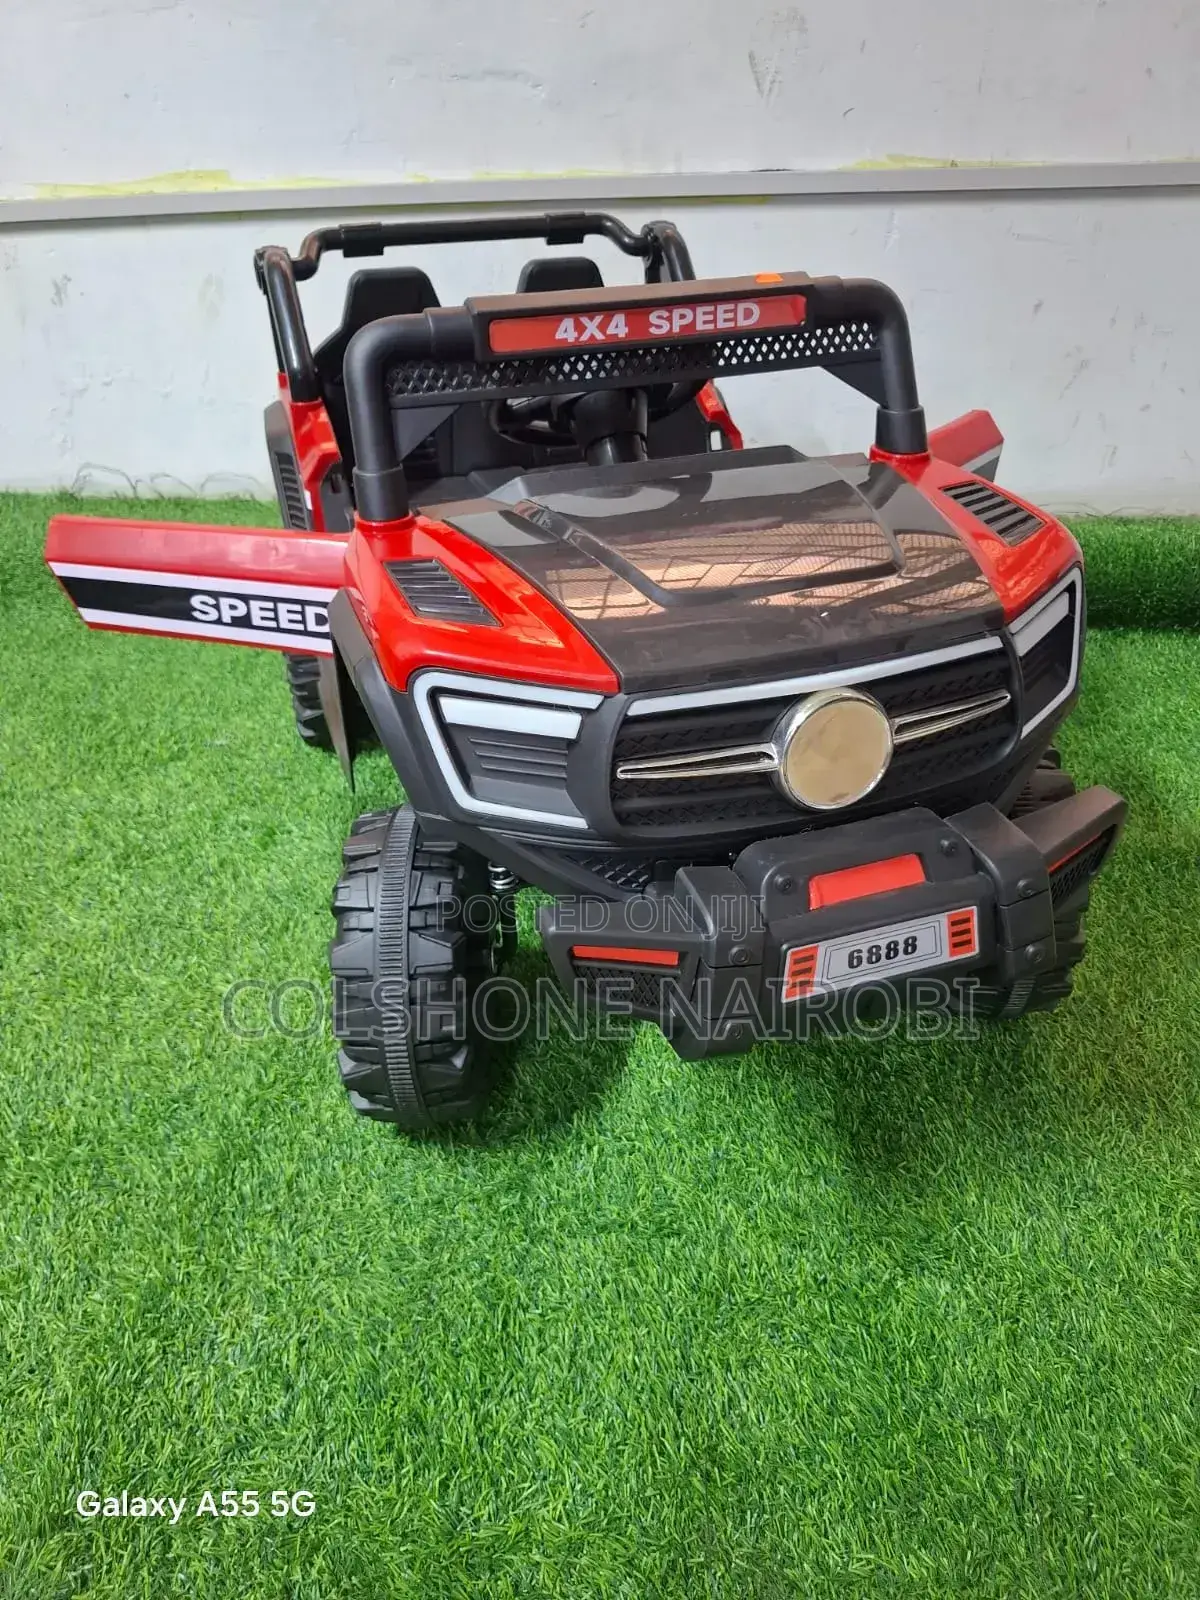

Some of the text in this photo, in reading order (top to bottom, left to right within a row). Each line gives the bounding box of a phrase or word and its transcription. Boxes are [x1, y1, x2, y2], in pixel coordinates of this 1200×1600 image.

[555, 302, 760, 343] 4X4 SPEED
[189, 594, 331, 632] SPEED
[847, 935, 919, 969] 6888
